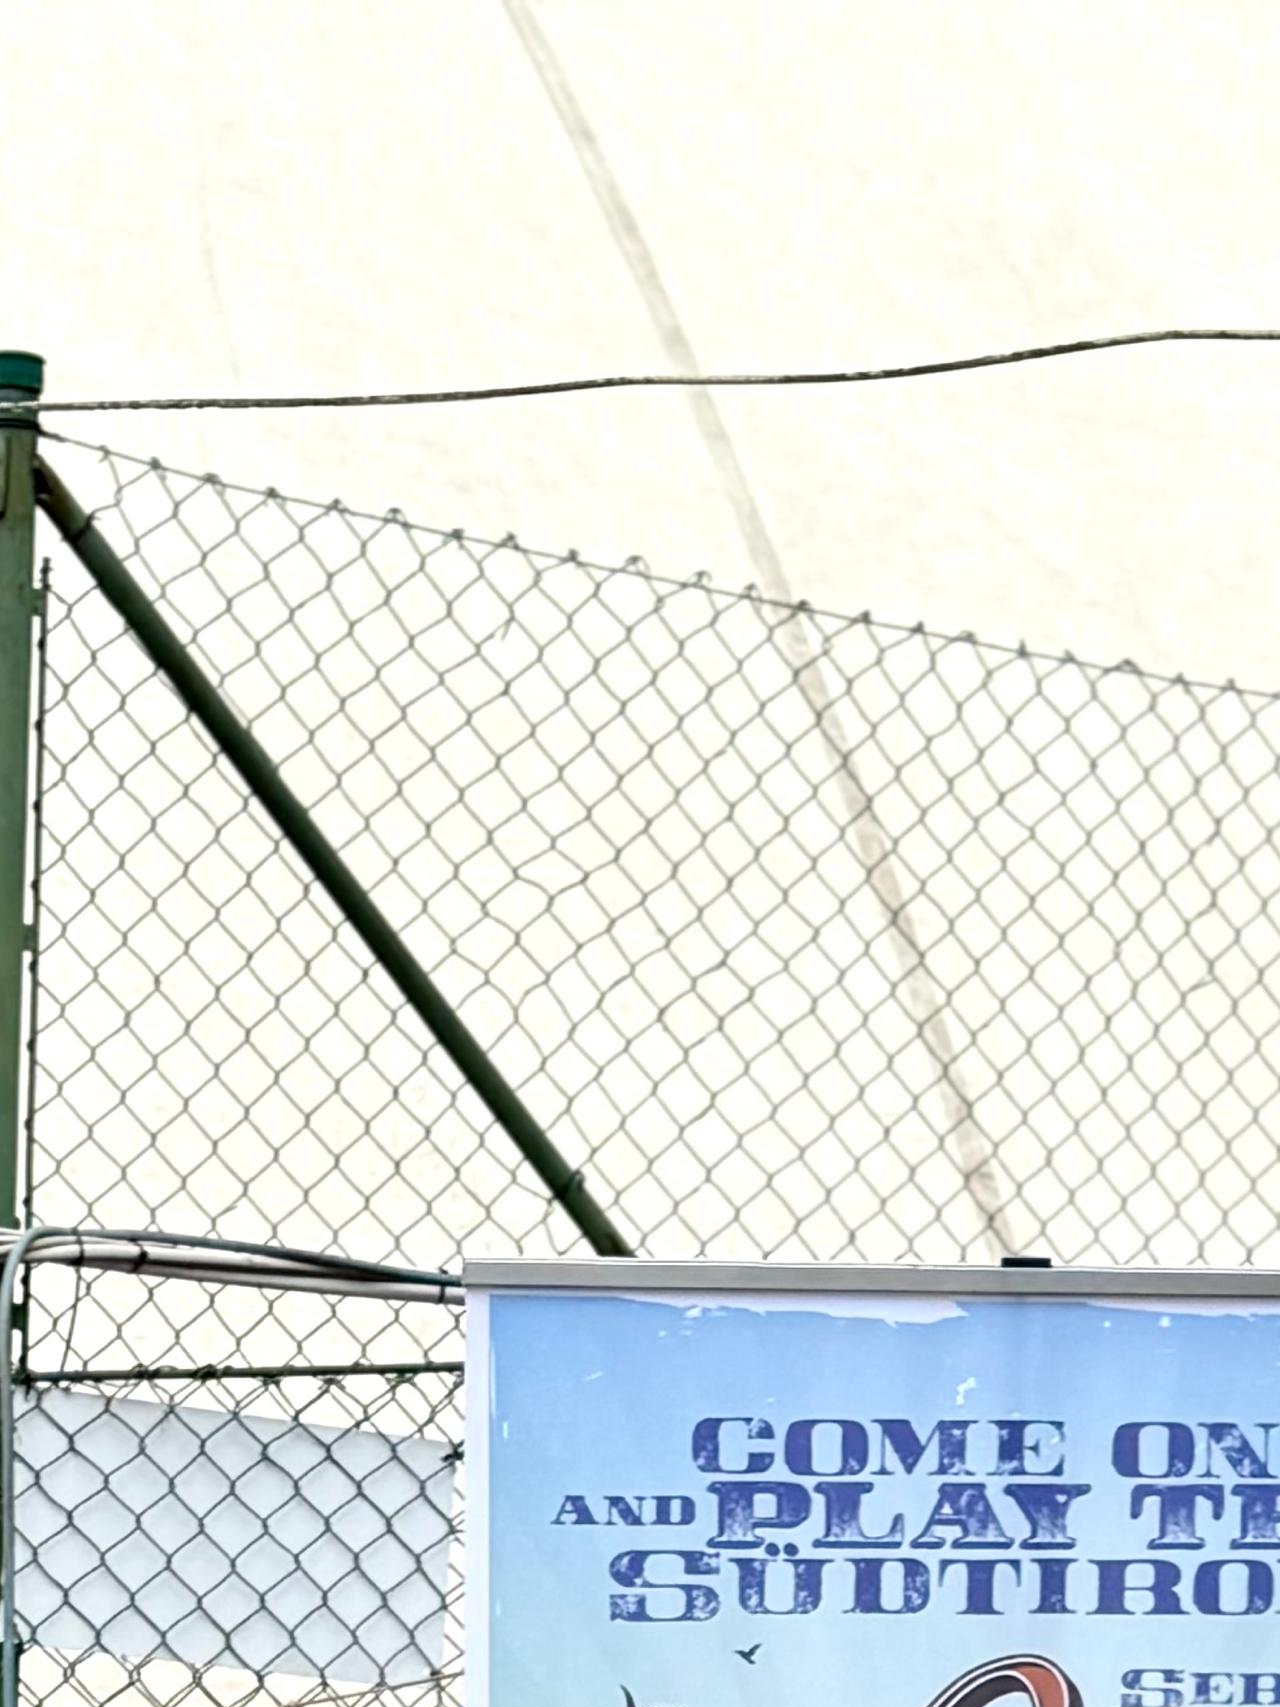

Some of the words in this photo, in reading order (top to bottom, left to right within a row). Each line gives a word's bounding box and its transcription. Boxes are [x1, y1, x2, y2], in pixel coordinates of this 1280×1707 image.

[691, 1417, 1065, 1477] COME
[550, 1495, 697, 1527] AND
[705, 1481, 1092, 1550] PLAY
